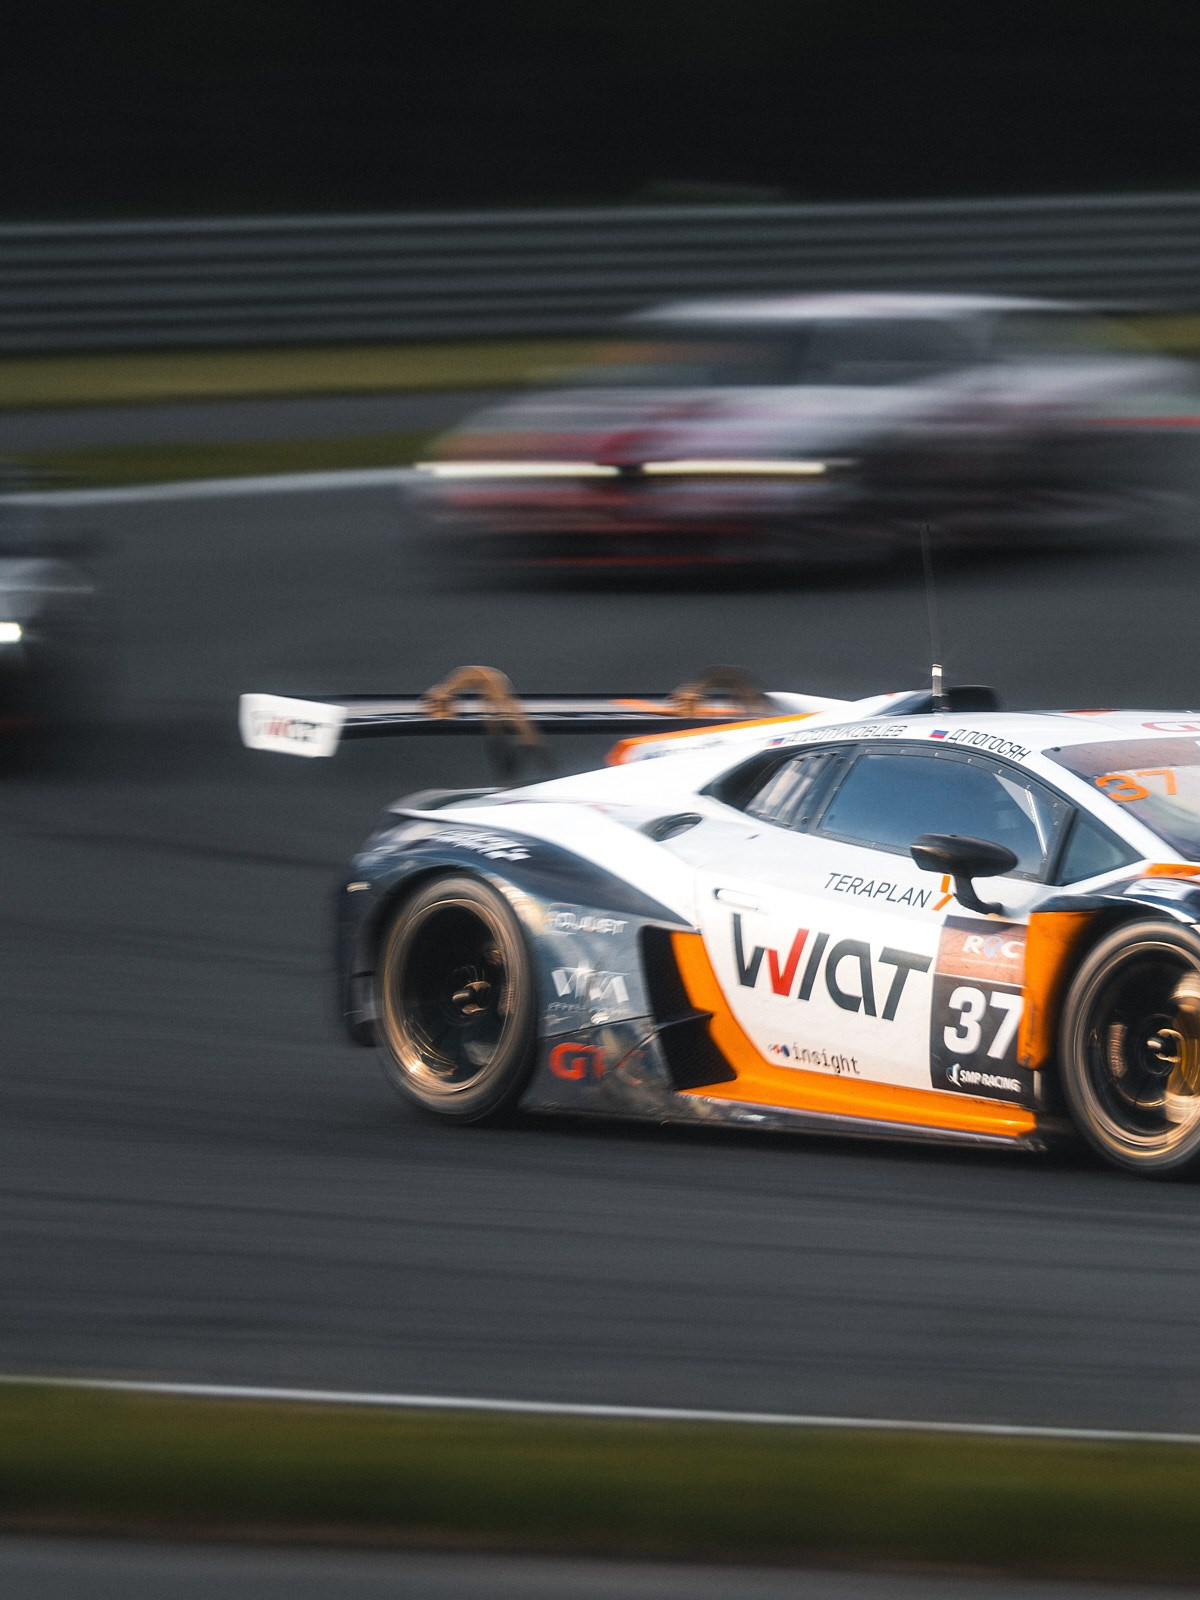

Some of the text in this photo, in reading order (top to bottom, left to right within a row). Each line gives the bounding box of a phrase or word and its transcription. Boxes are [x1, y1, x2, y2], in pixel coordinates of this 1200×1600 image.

[947, 728, 1032, 762] Д.ПОГОСЯН
[1094, 767, 1177, 802] 37
[824, 872, 932, 909] TERAPLAN
[943, 986, 1025, 1060] 37
[792, 1043, 861, 1075] insight
[959, 1069, 1022, 1093] SMP RACING
